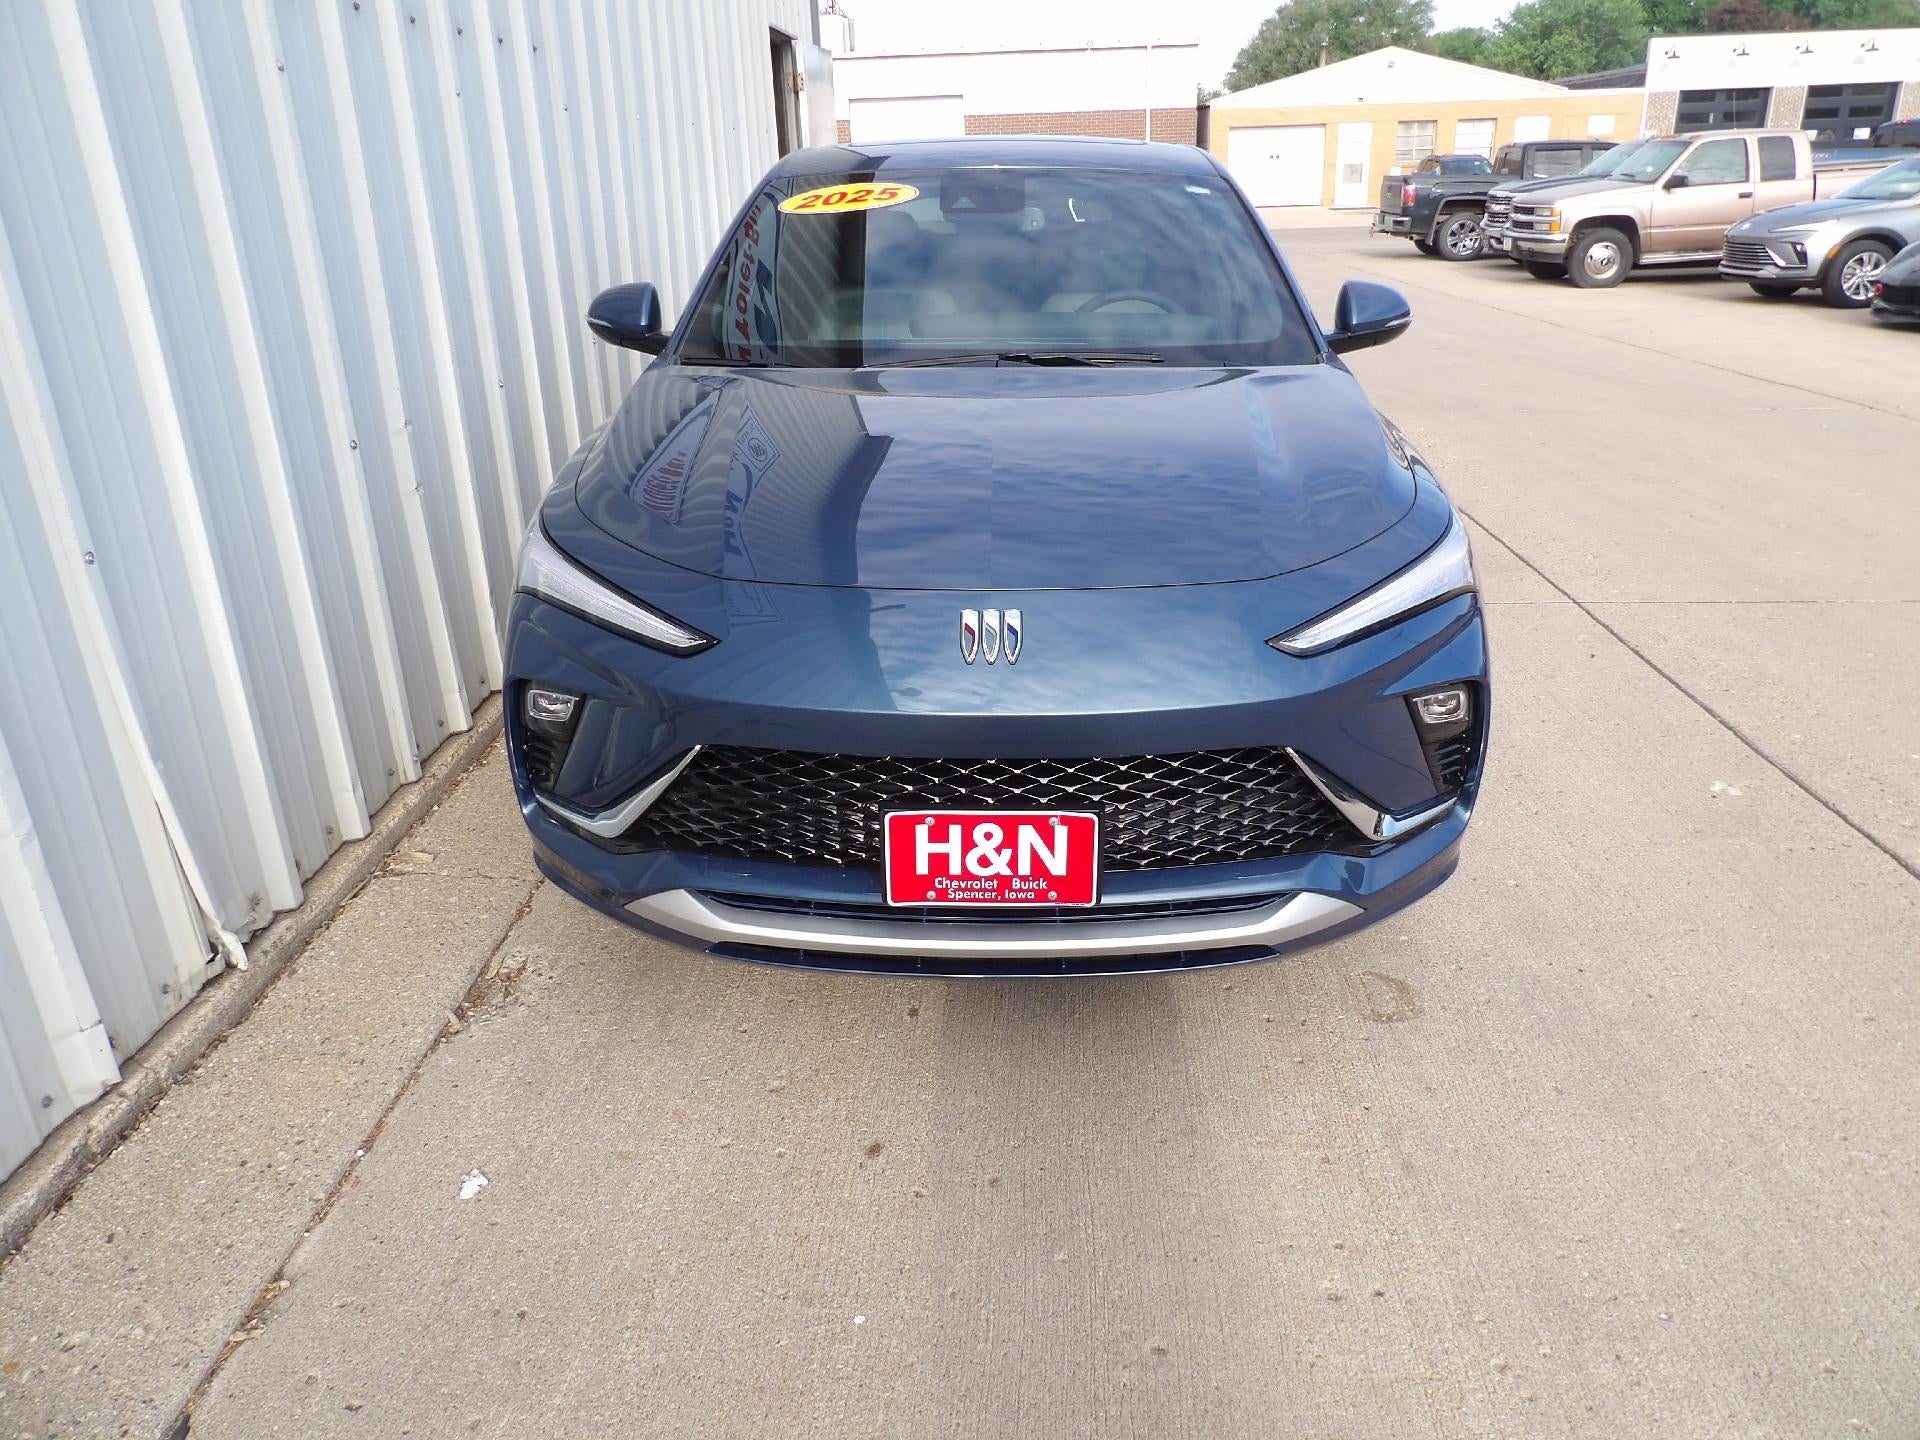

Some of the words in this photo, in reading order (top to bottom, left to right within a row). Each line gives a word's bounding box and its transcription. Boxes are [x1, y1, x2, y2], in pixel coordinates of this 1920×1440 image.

[793, 187, 902, 211] 2025
[914, 822, 1069, 877] H&N
[934, 877, 998, 890] Chevrolet
[1012, 877, 1047, 889] Buick
[947, 888, 1001, 900] Spencer,
[1005, 889, 1035, 899] Iowa
